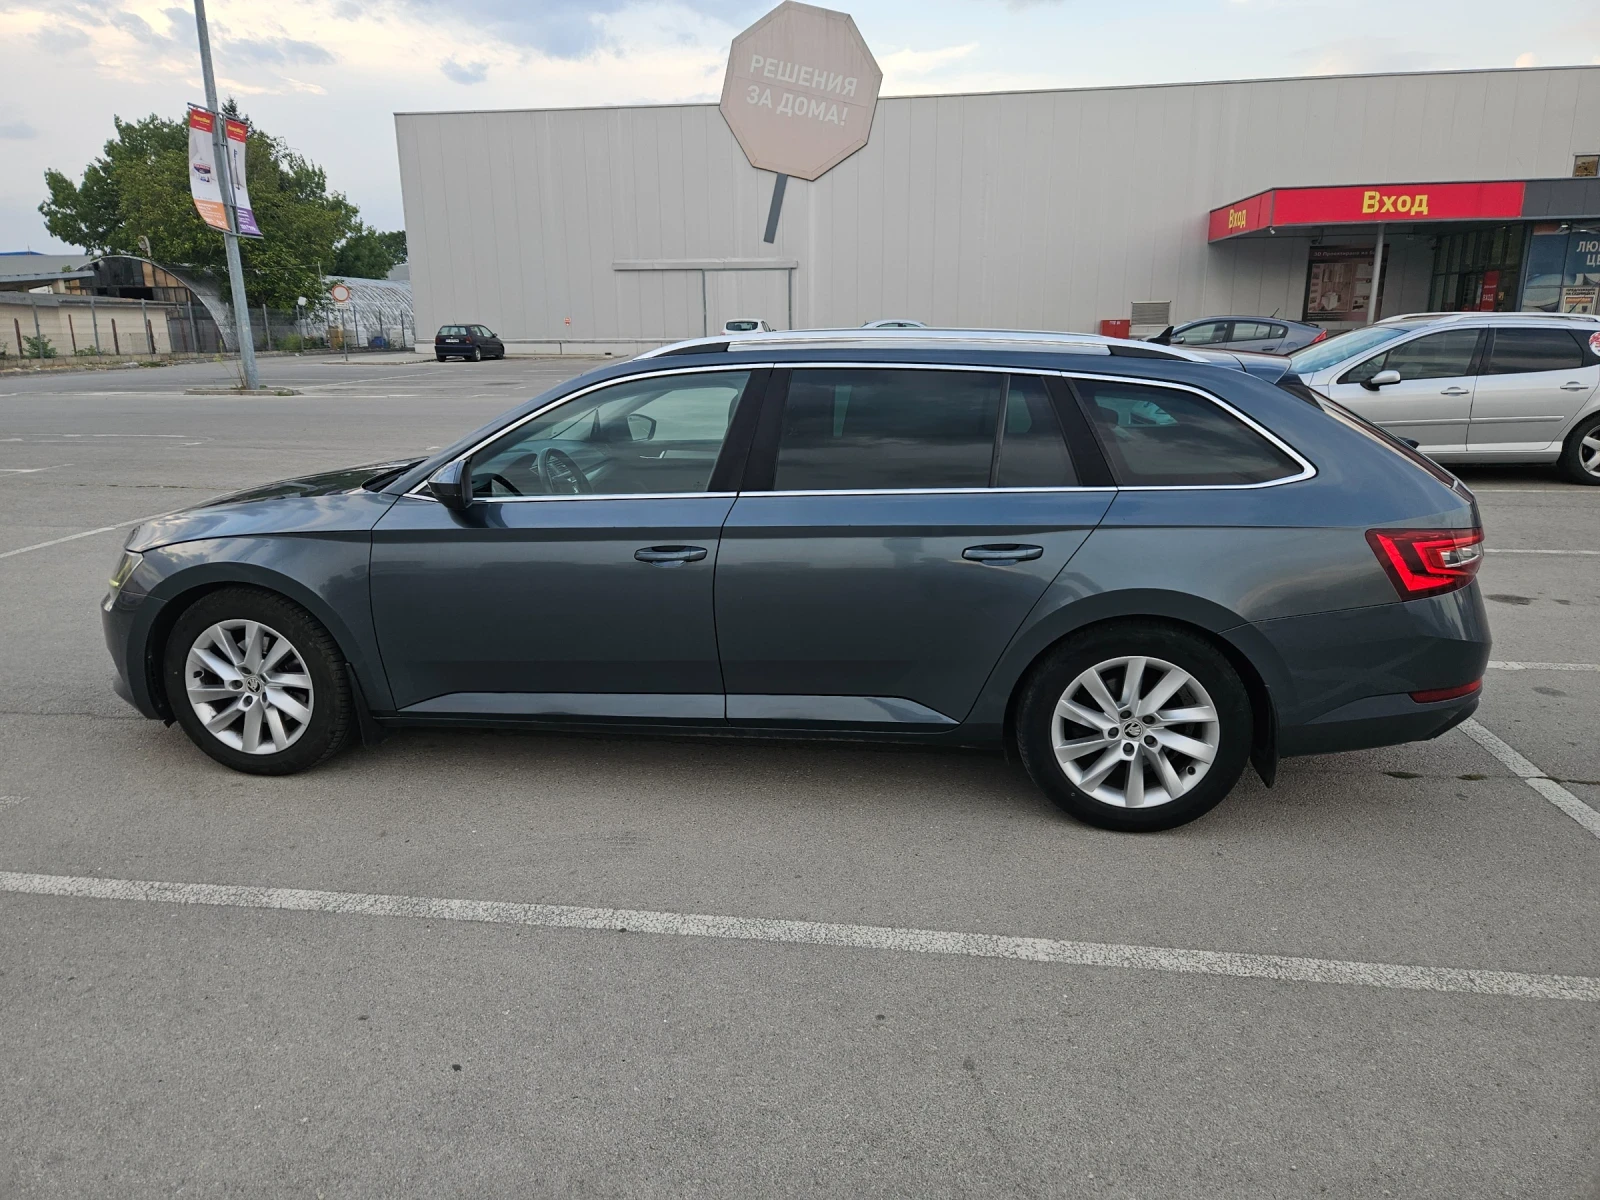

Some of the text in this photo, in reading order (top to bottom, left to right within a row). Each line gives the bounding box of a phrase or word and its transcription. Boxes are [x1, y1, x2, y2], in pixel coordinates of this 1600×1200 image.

[750, 54, 858, 97] РЕШЕНИЯ
[746, 85, 849, 126] ЗА ДОМА!
[1362, 190, 1429, 216] Вход
[1228, 209, 1247, 229] Вход
[1576, 241, 1600, 252] ЛЮ
